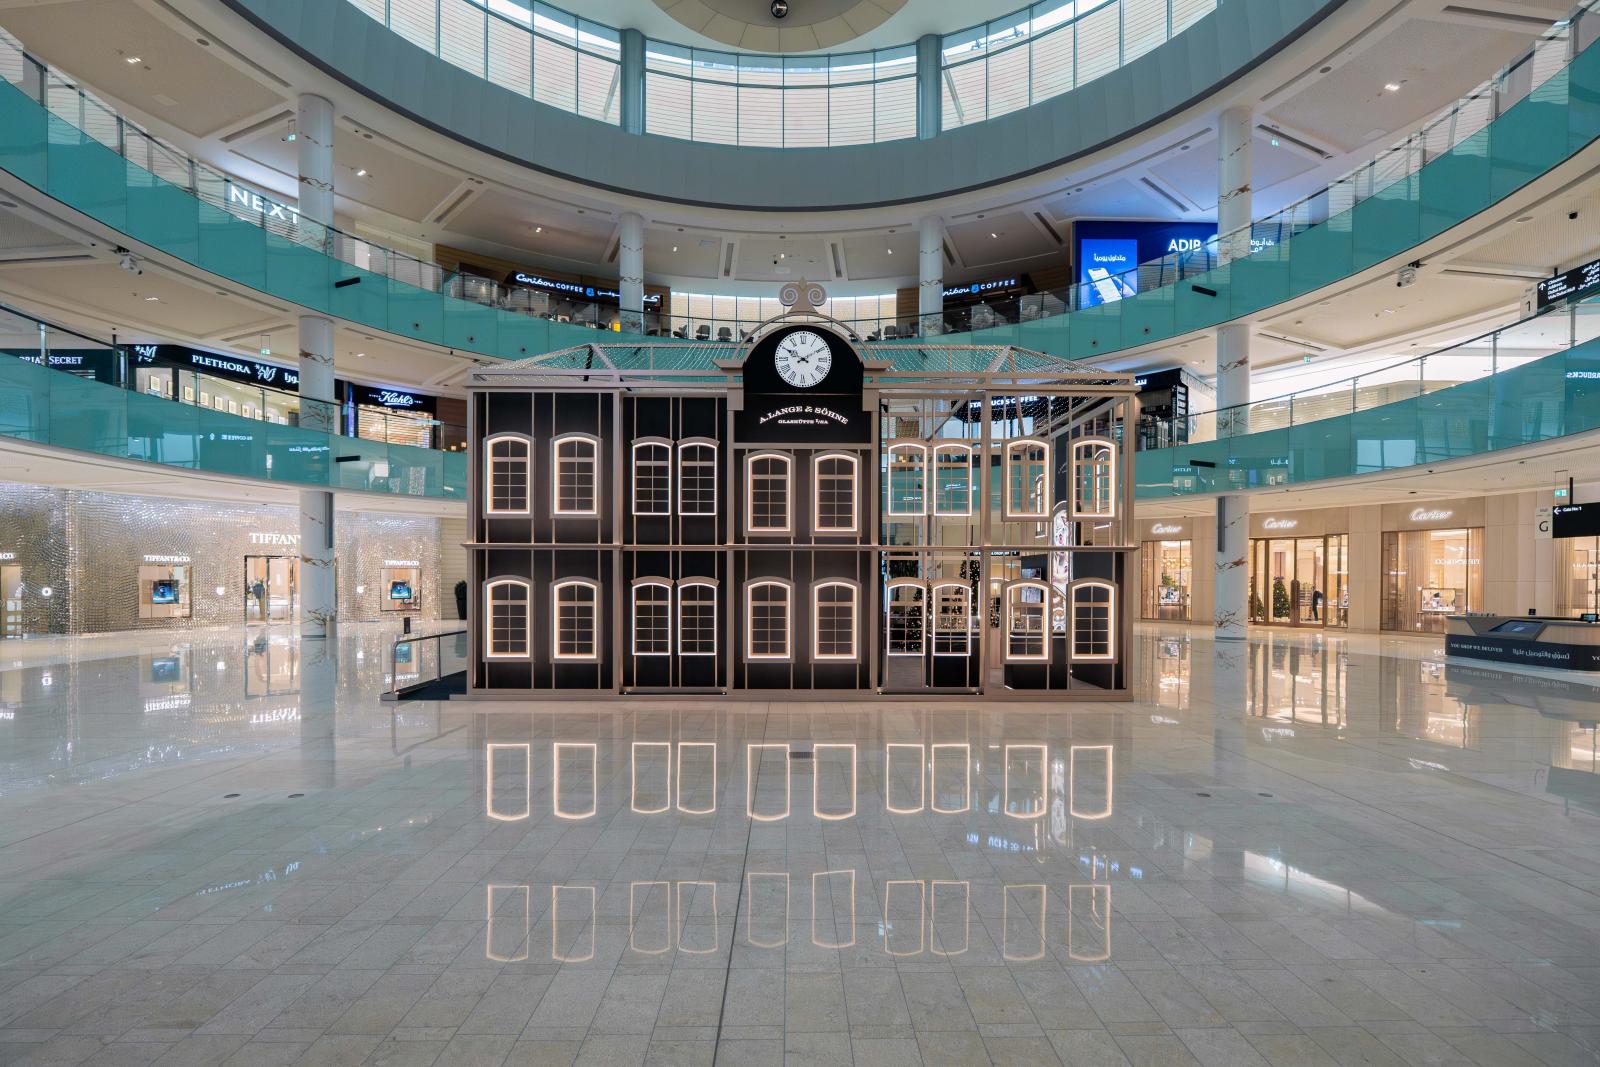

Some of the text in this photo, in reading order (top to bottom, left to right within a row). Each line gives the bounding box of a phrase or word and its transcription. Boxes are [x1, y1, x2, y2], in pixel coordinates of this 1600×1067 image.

[231, 185, 300, 224] NEXT
[515, 273, 583, 293] Caribou COFFEE
[980, 279, 1015, 290] COFFEE
[49, 356, 84, 365] SECRET
[191, 354, 251, 374] PLETHORA
[378, 391, 414, 405] Kiehl's
[804, 405, 813, 413] &
[814, 407, 849, 425] SÖHNE
[1409, 507, 1453, 521] Cartier
[1151, 523, 1183, 534] Cartier
[1263, 518, 1298, 530] Cartier
[1539, 520, 1549, 533] G
